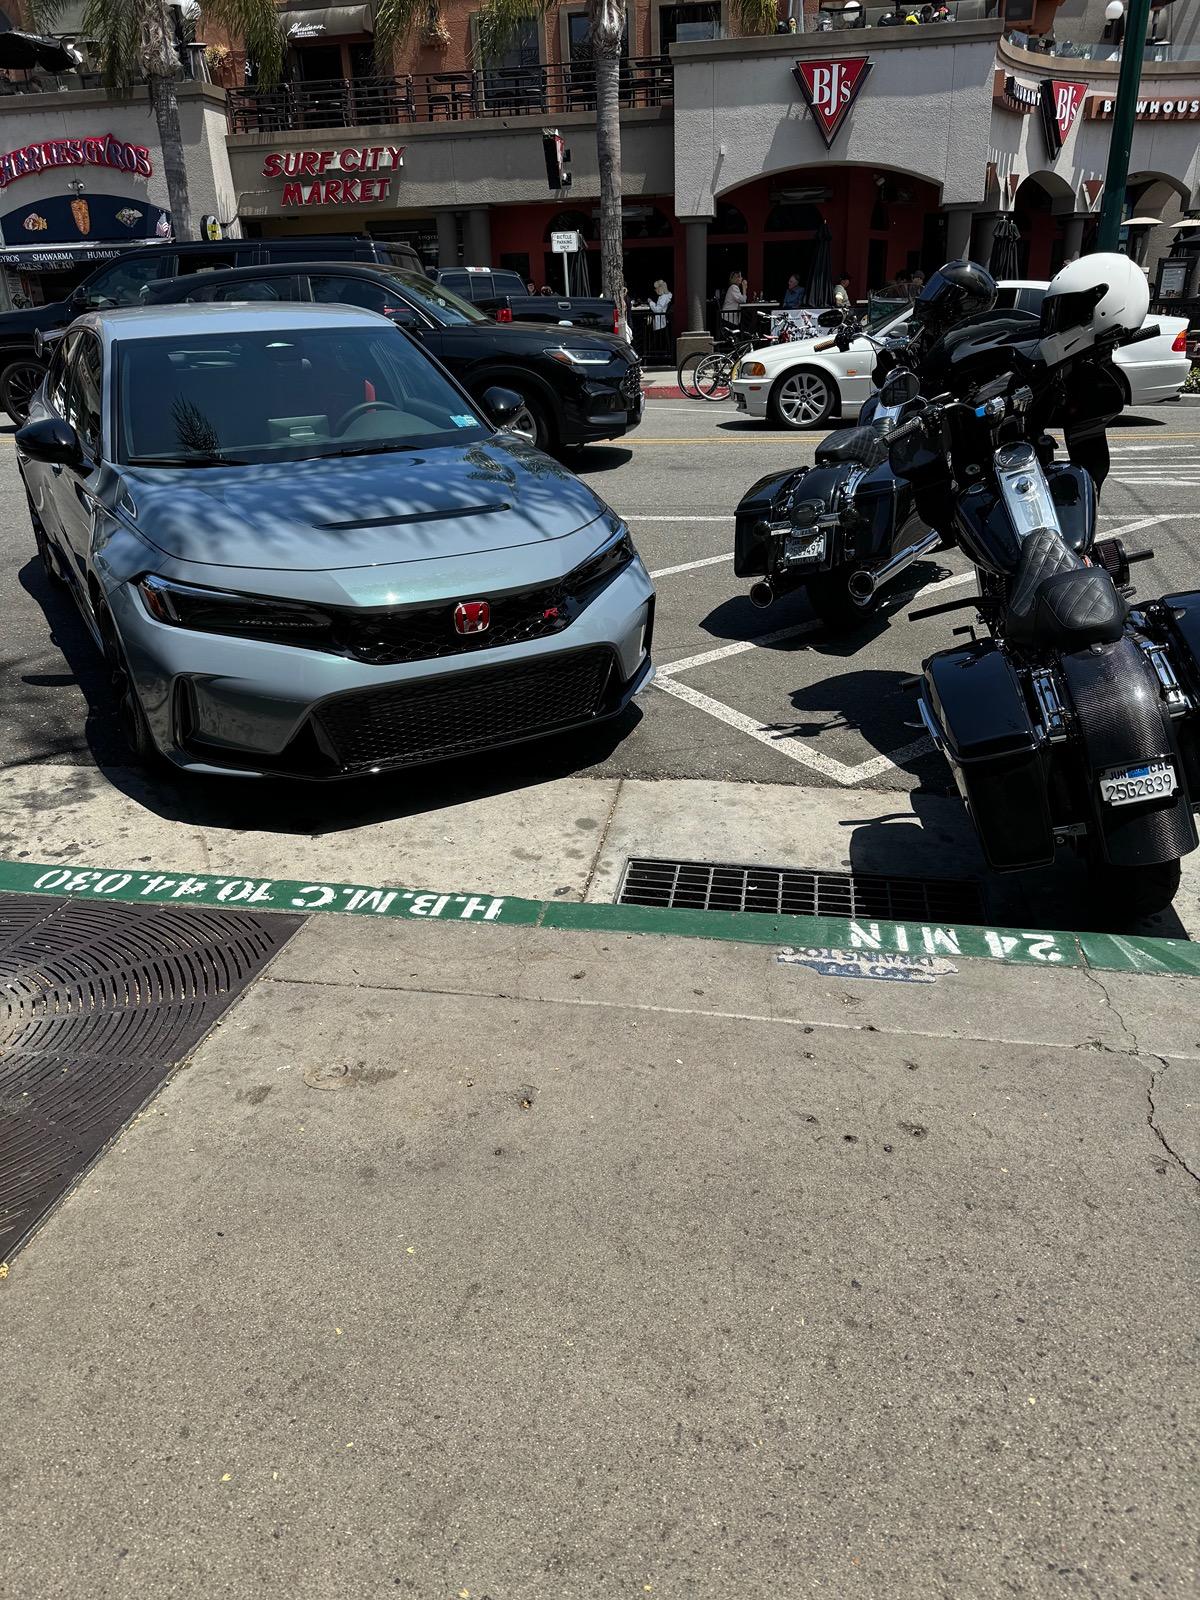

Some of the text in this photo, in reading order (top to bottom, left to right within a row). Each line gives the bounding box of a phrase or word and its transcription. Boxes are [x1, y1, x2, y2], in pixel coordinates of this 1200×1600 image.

[811, 63, 851, 116] BJ's
[1055, 86, 1078, 131] BJ's
[81, 135, 152, 177] GYROS
[261, 146, 406, 178] SURF CITY
[281, 178, 392, 207] MARKET
[32, 252, 74, 262] SHAWARMA
[86, 250, 121, 259] HUMMUS
[1105, 774, 1172, 801] 25G2839
[1109, 769, 1127, 780] JUN
[34, 869, 274, 902] 10.44.030
[849, 921, 1062, 962] 24 MIN
